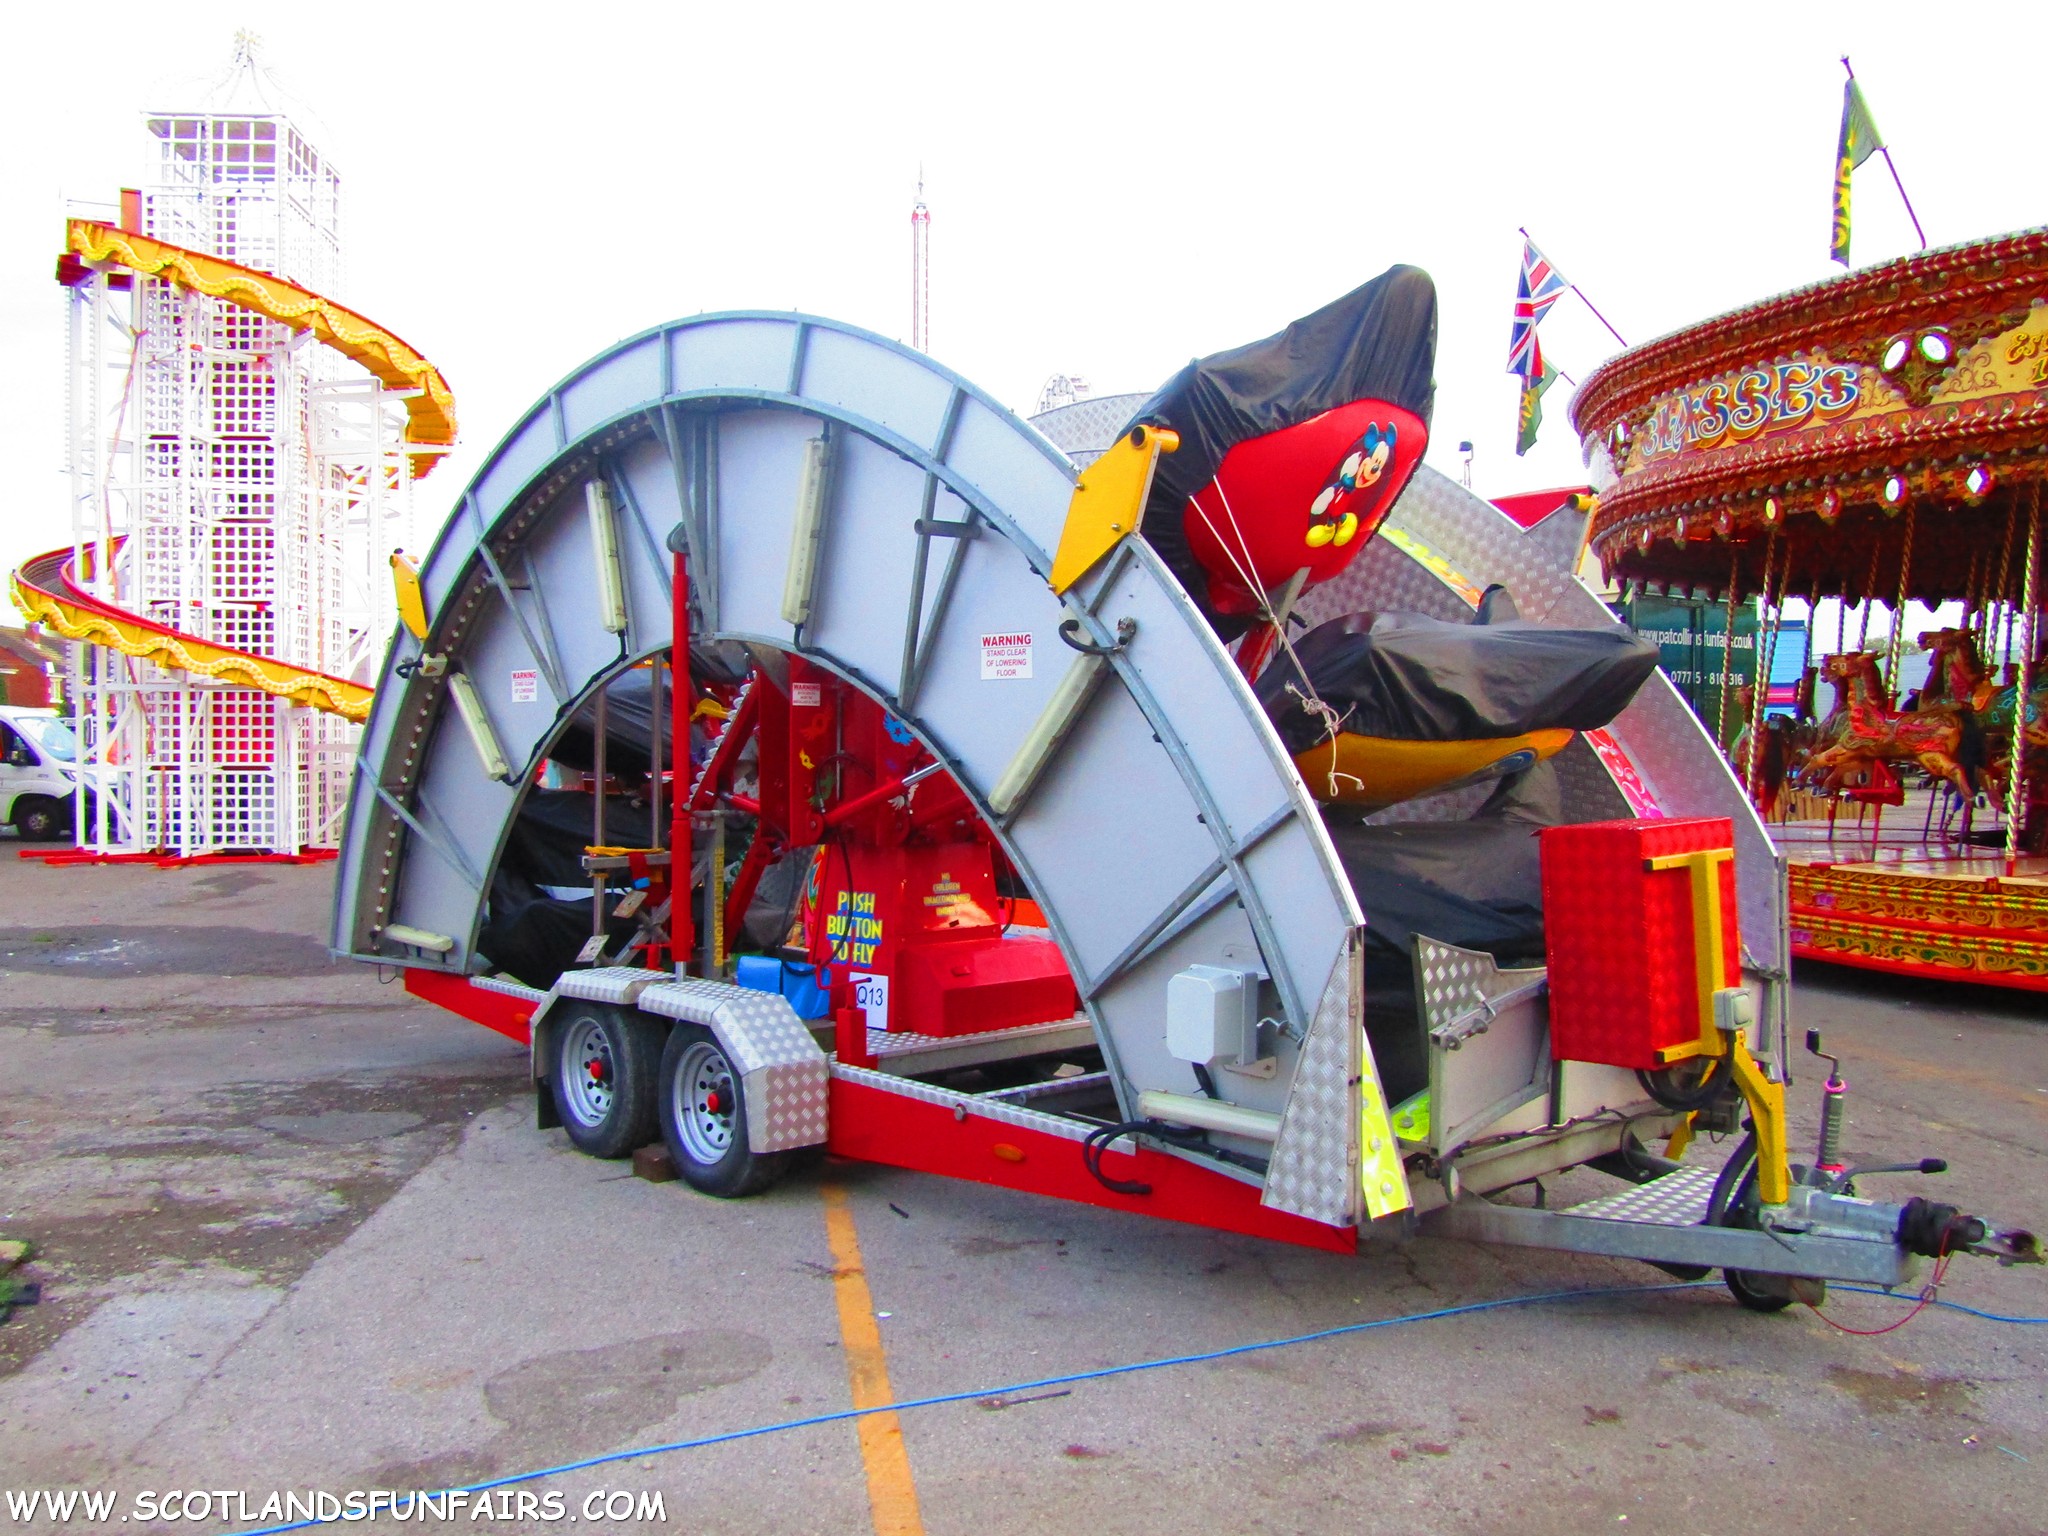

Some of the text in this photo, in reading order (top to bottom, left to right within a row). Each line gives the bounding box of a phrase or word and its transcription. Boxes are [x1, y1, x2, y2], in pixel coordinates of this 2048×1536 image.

[982, 634, 1031, 647] WARNING
[987, 648, 1026, 657] STAND CLEAR
[996, 658, 1026, 667] LOWERING
[1729, 673, 1744, 685] 316
[838, 891, 876, 914] PUSH
[831, 940, 876, 965] TO FLY
[858, 986, 883, 1006] Q13
